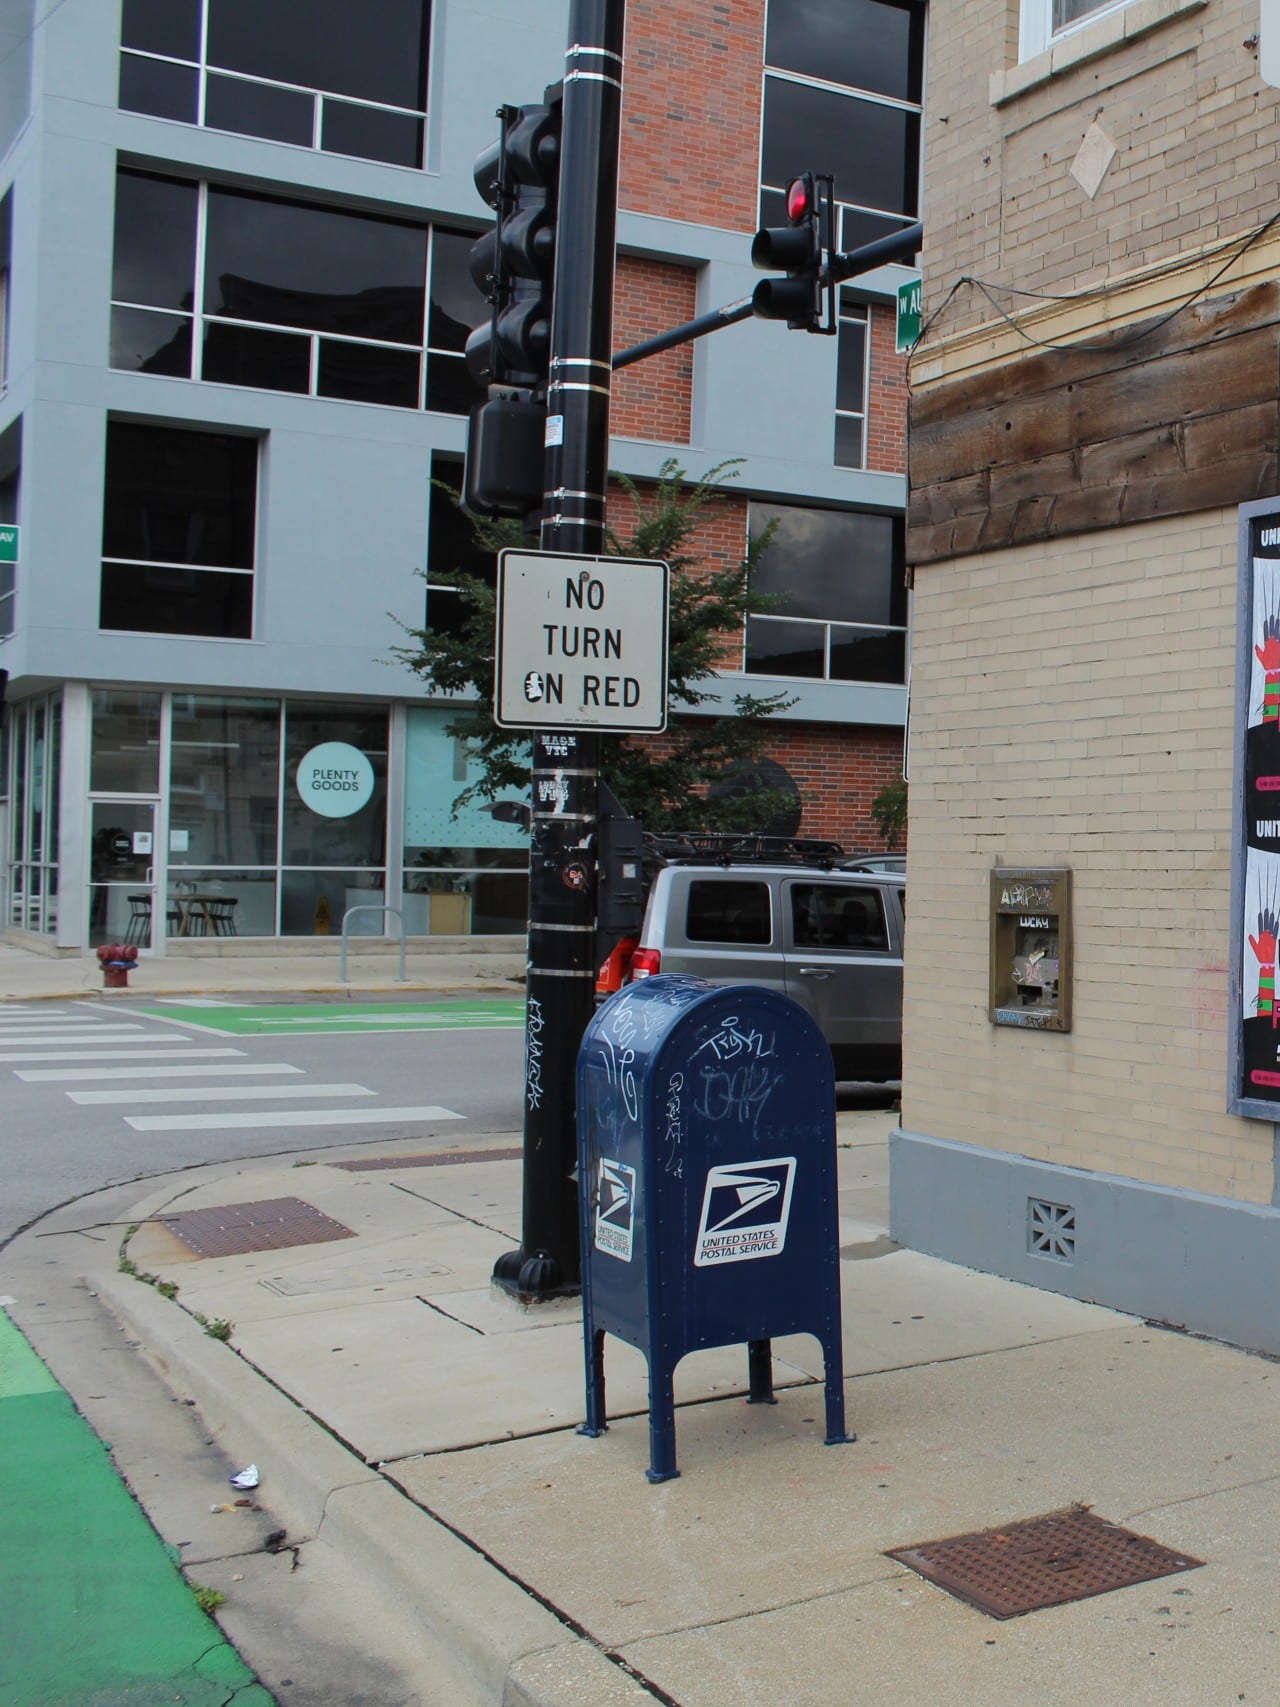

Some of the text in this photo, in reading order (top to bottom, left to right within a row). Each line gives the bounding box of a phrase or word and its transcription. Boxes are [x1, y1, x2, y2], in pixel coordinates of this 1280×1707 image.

[900, 296, 908, 315] W
[566, 578, 604, 610] NO
[543, 625, 621, 658] TURN
[525, 671, 639, 707] ON RED
[312, 769, 359, 780] PLENTY
[312, 781, 359, 792] GOODS
[1020, 917, 1048, 928] LUCKY
[702, 1230, 775, 1249] UNITED STATES
[700, 1241, 777, 1260] POSTAL SERVICE
